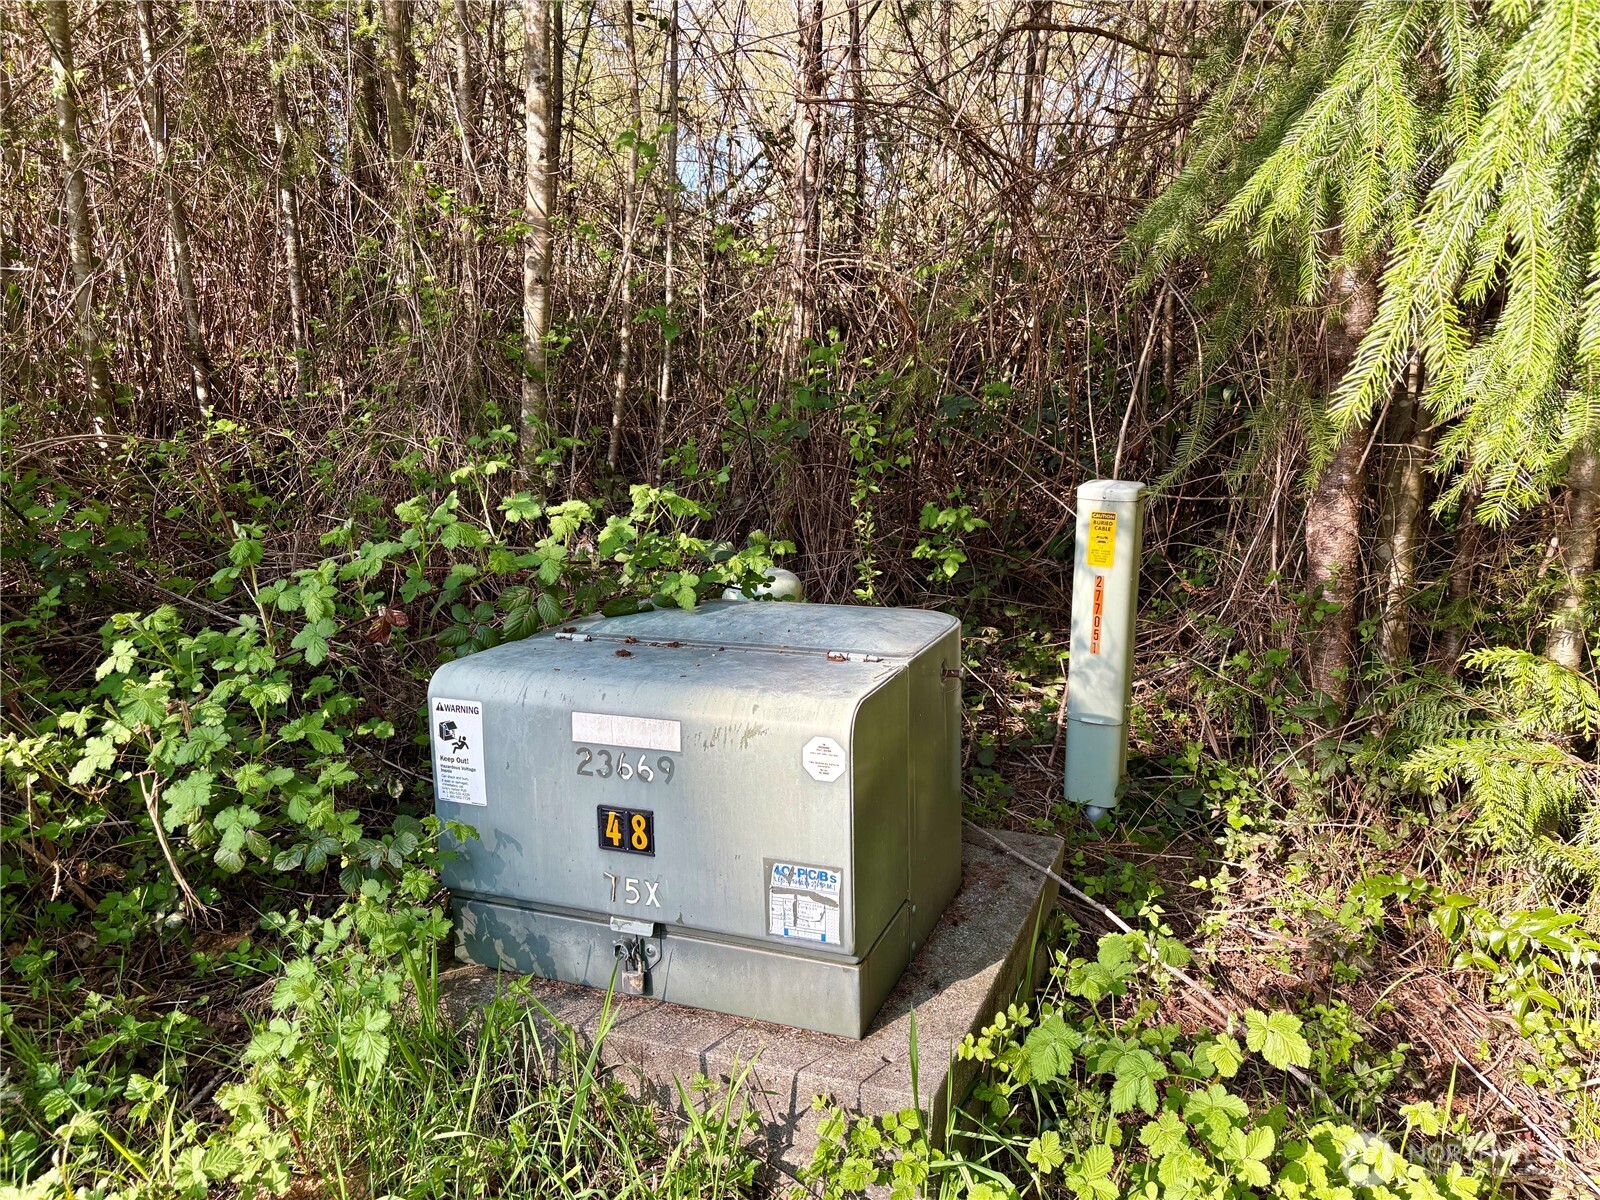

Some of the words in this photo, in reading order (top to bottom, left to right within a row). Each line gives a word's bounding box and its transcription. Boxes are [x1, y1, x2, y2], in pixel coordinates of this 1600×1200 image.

[443, 703, 480, 715] WARNING
[440, 755, 454, 763] Keep
[576, 747, 676, 785] 23669
[605, 811, 648, 850] 48
